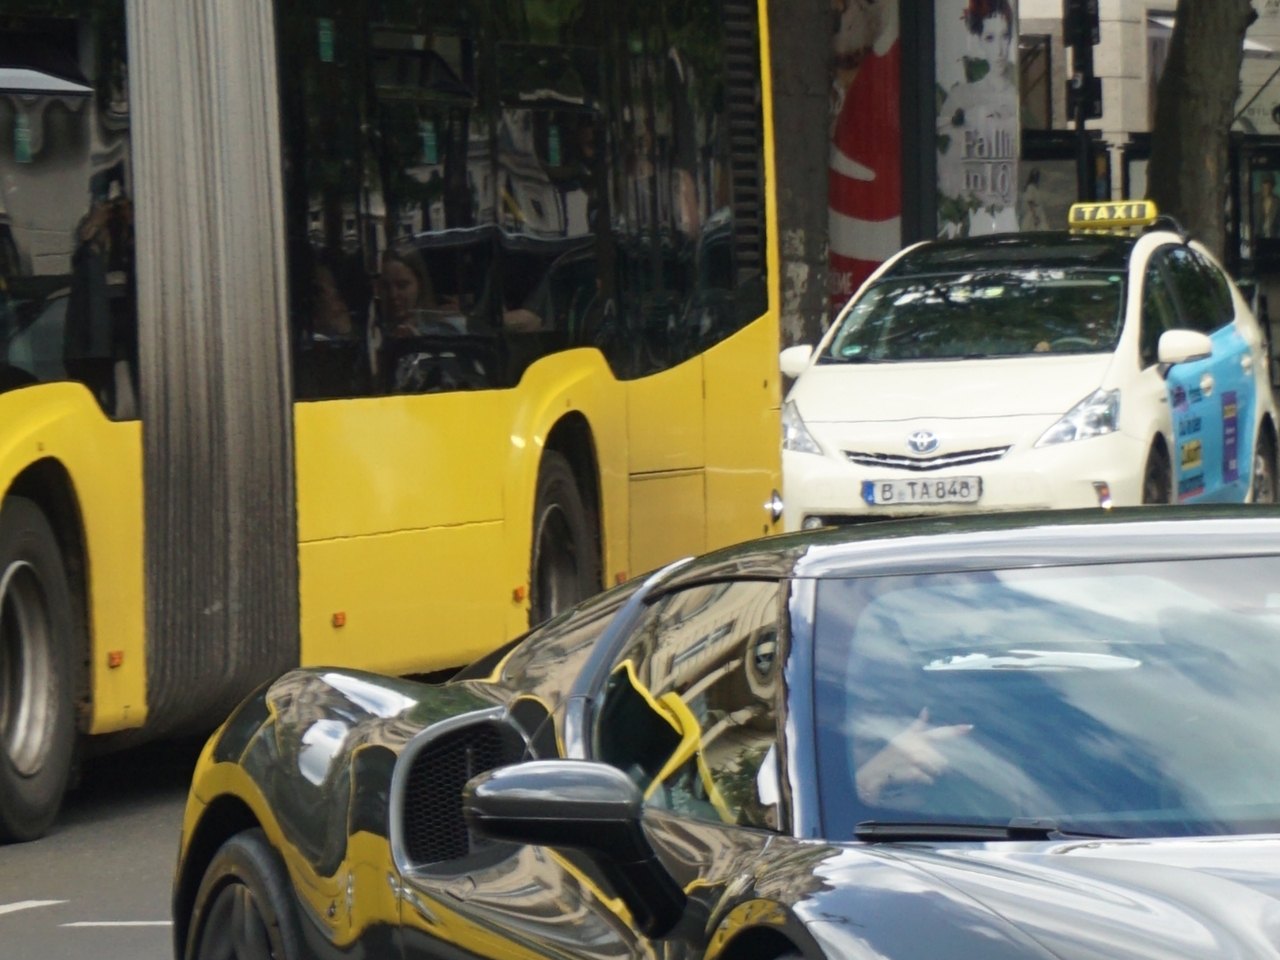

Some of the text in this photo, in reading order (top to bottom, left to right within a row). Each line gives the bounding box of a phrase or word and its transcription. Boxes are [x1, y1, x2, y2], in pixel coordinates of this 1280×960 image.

[1081, 204, 1138, 221] TAXI
[881, 483, 893, 501] B
[906, 481, 930, 500] TA
